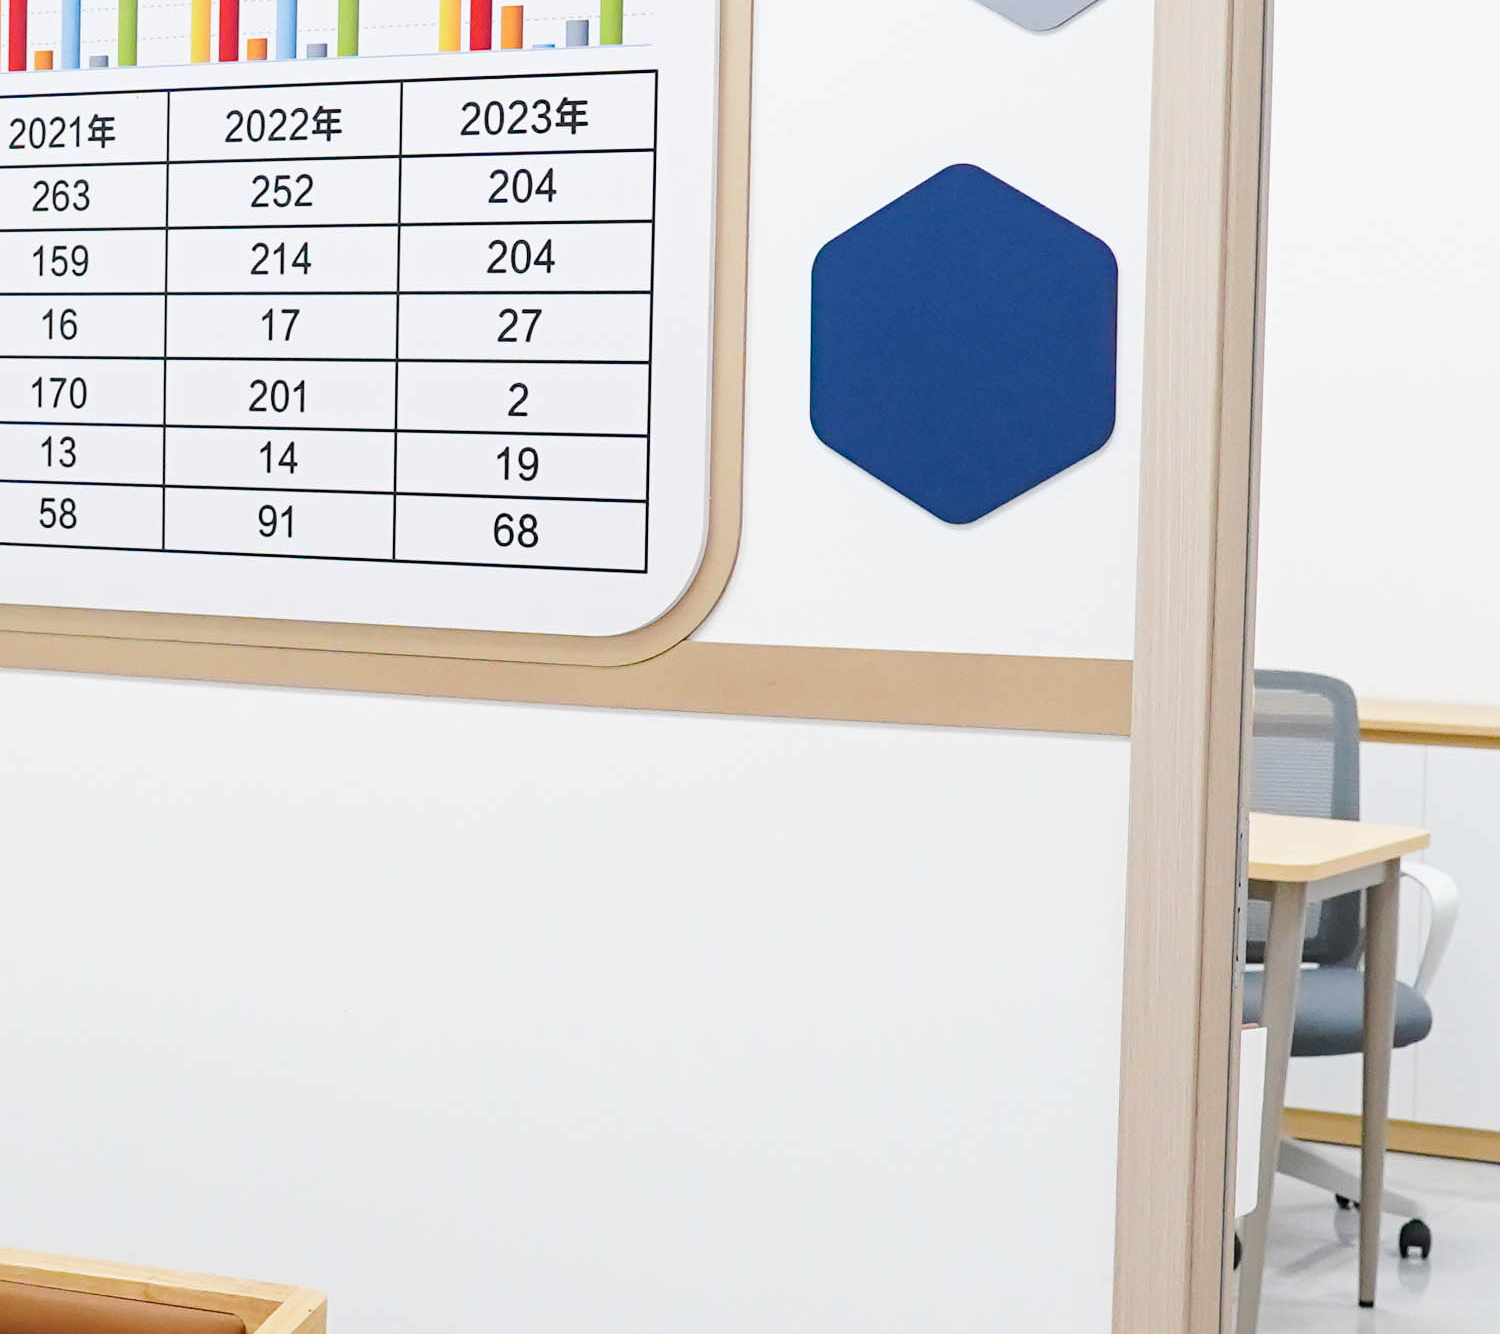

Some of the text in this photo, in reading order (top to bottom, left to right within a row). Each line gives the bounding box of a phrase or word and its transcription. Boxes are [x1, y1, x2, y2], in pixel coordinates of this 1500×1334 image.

[8, 113, 116, 150] 2021年
[224, 105, 343, 143] 2022年
[460, 96, 589, 136] 2023年
[32, 179, 90, 212] 263
[250, 173, 314, 208] 252
[488, 167, 557, 204] 204
[33, 244, 89, 277] 159
[250, 241, 312, 275] 214
[486, 238, 556, 274] 204
[42, 308, 78, 341] 16
[261, 308, 300, 342] 17
[497, 308, 543, 343] 27
[31, 376, 87, 409] 170
[248, 379, 305, 413] 201
[507, 382, 529, 417] 2
[41, 435, 77, 468] 13
[259, 440, 298, 474] 14
[497, 446, 539, 482] 19
[39, 497, 77, 530] 58
[258, 504, 293, 538] 91
[493, 512, 539, 548] 68
